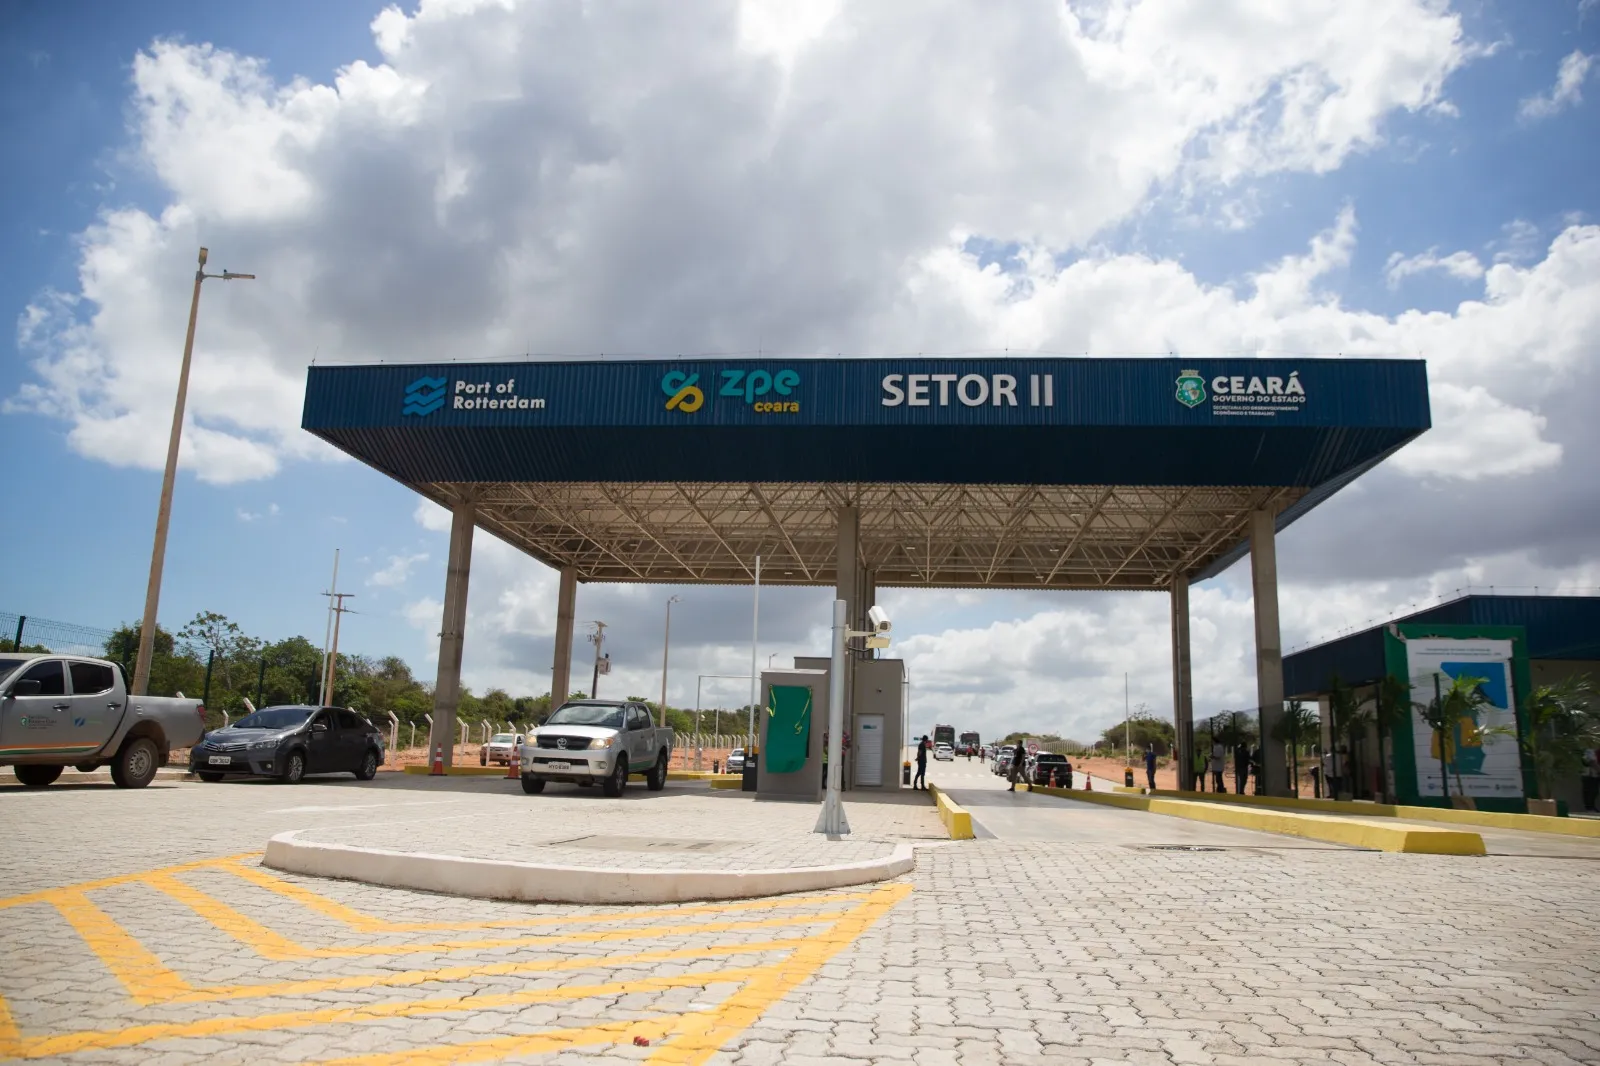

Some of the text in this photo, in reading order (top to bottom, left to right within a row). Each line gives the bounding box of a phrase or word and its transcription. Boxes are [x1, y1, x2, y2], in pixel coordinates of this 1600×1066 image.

[455, 378, 515, 394] Port of
[720, 369, 800, 404] zpe
[881, 373, 1053, 407] SETOR II
[1211, 370, 1306, 395] CEARÁ
[453, 395, 546, 409] Rotterdam
[1212, 395, 1255, 403] GOVERNO
[1271, 396, 1306, 404] ESTADO
